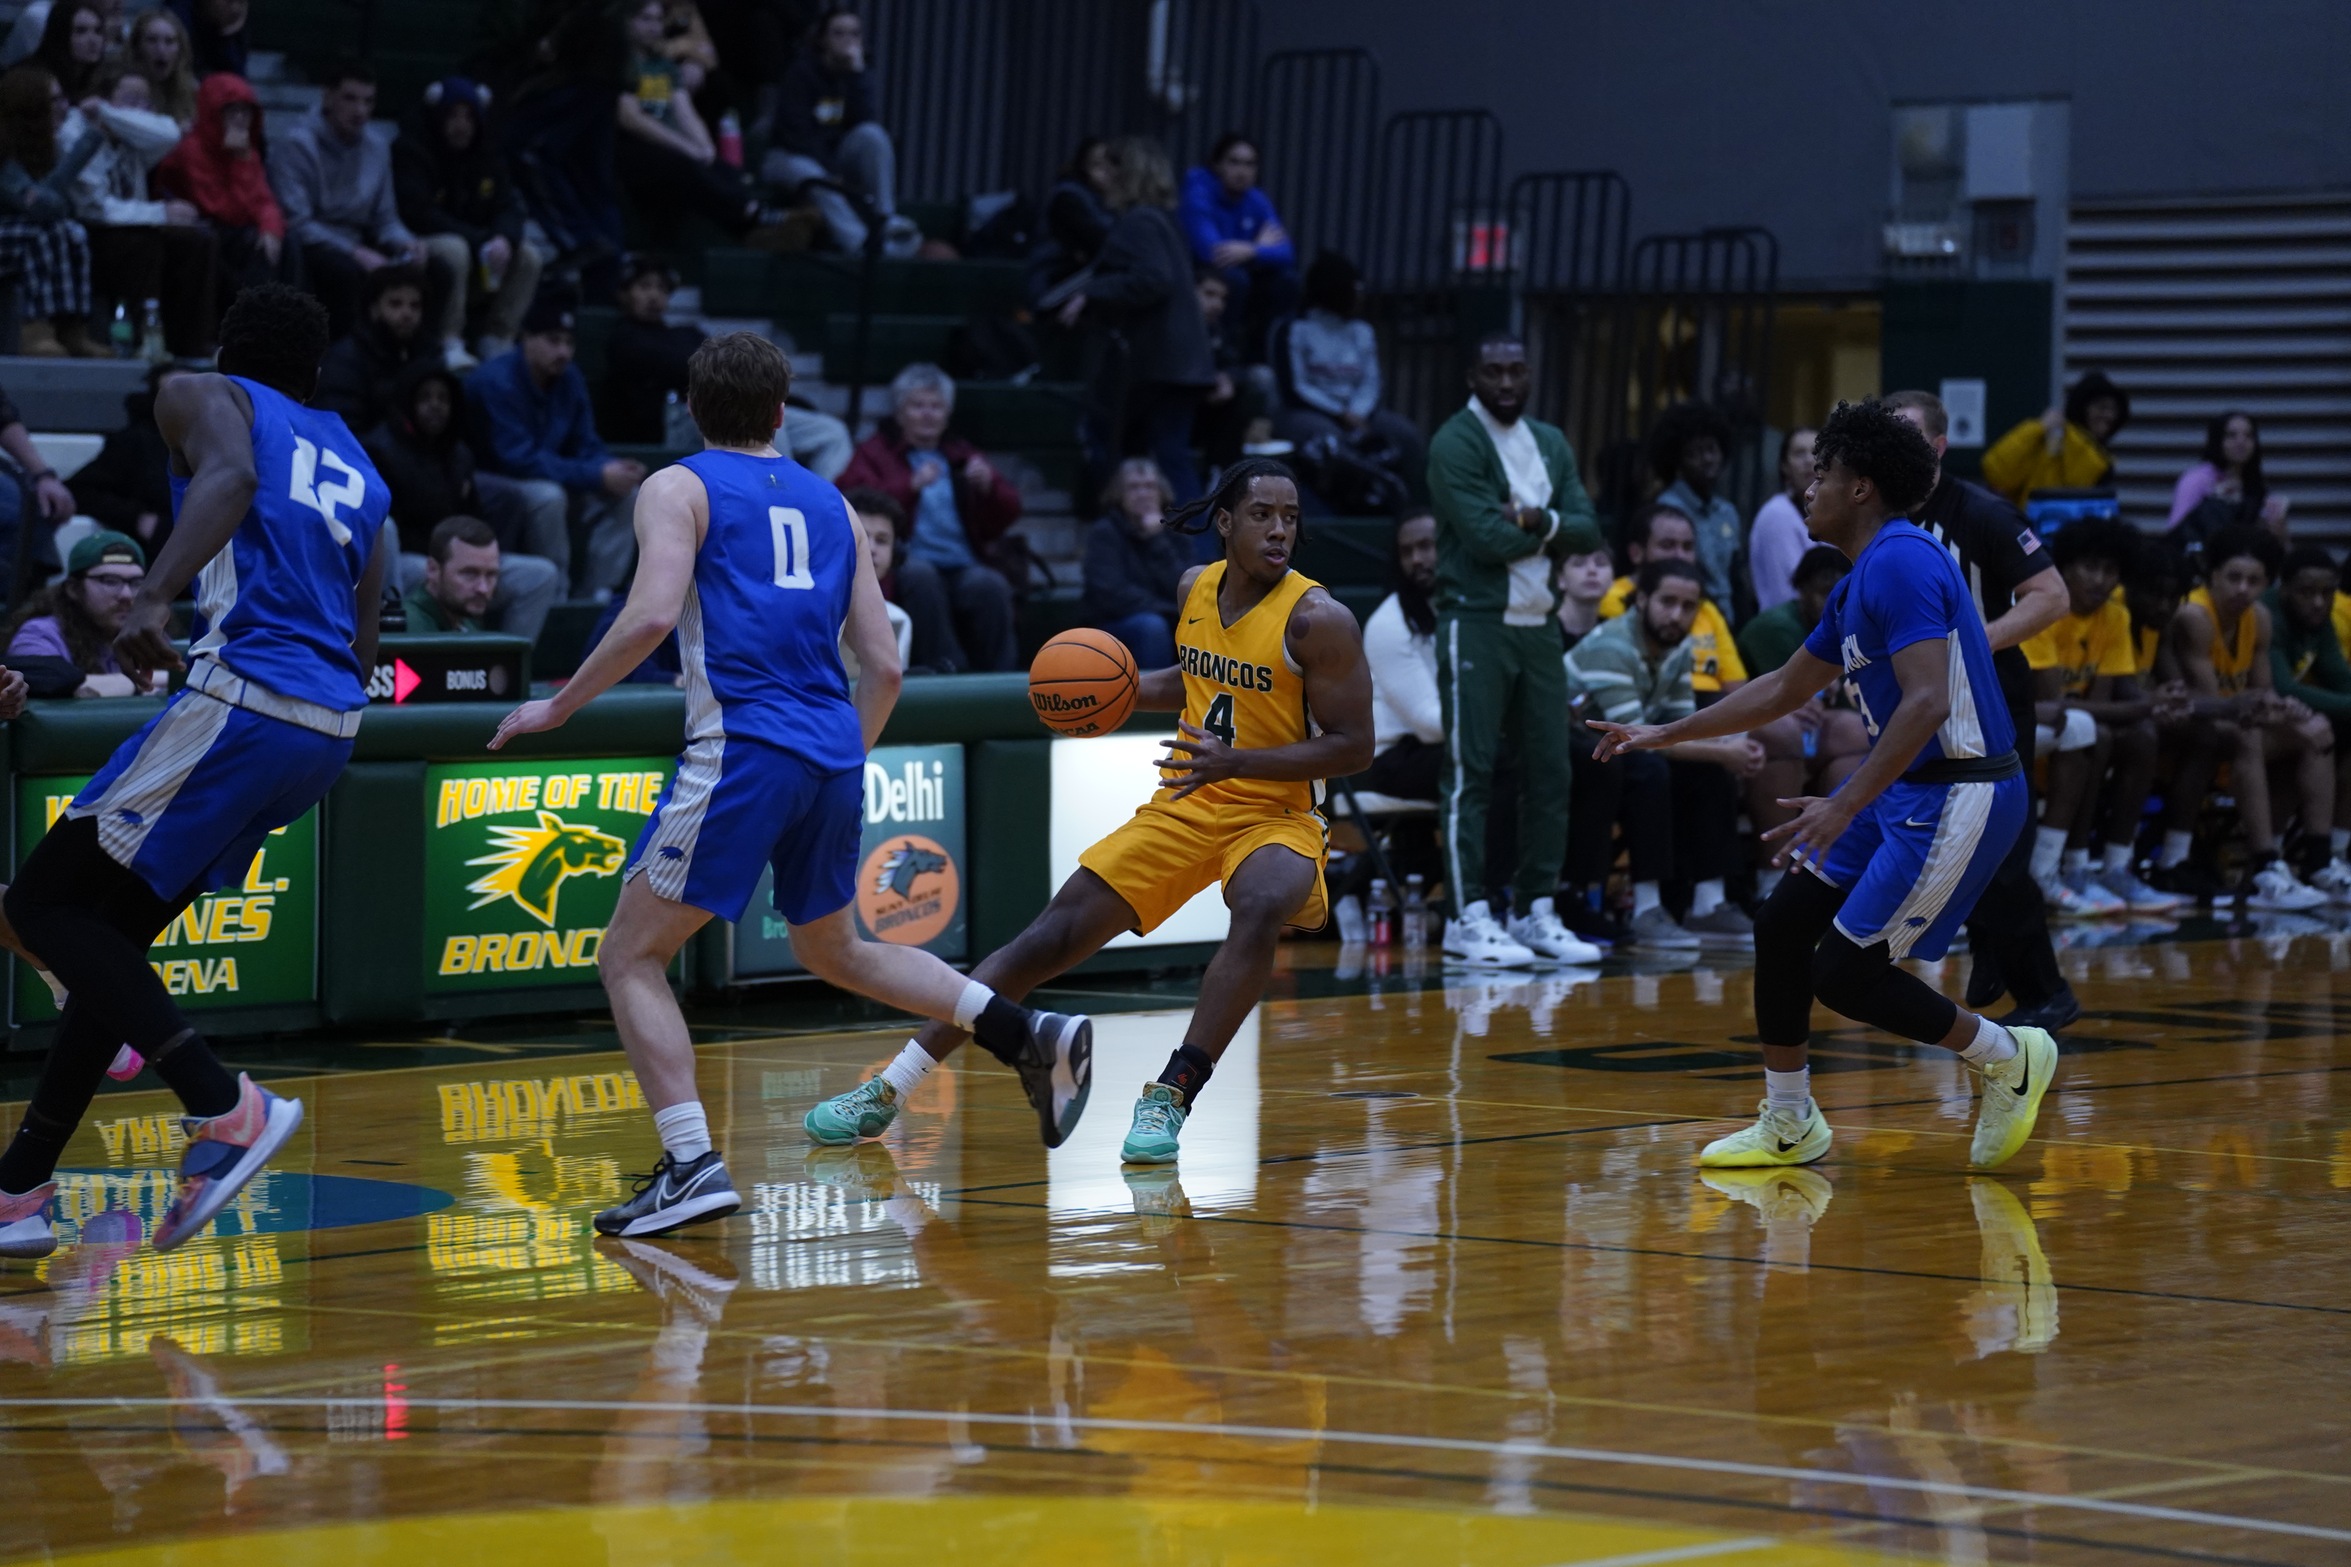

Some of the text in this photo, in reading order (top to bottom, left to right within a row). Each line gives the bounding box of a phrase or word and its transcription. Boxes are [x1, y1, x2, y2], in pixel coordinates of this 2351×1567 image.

[768, 505, 815, 590] 0
[445, 668, 488, 691] BONUS
[1179, 644, 1273, 692] BRONCOS
[1032, 691, 1099, 712] Wilson
[1203, 691, 1237, 748] 4
[436, 771, 665, 829] HOME OF THE
[863, 760, 945, 824] Delhi
[148, 957, 240, 996] ENA
[438, 927, 609, 977] BRONC
